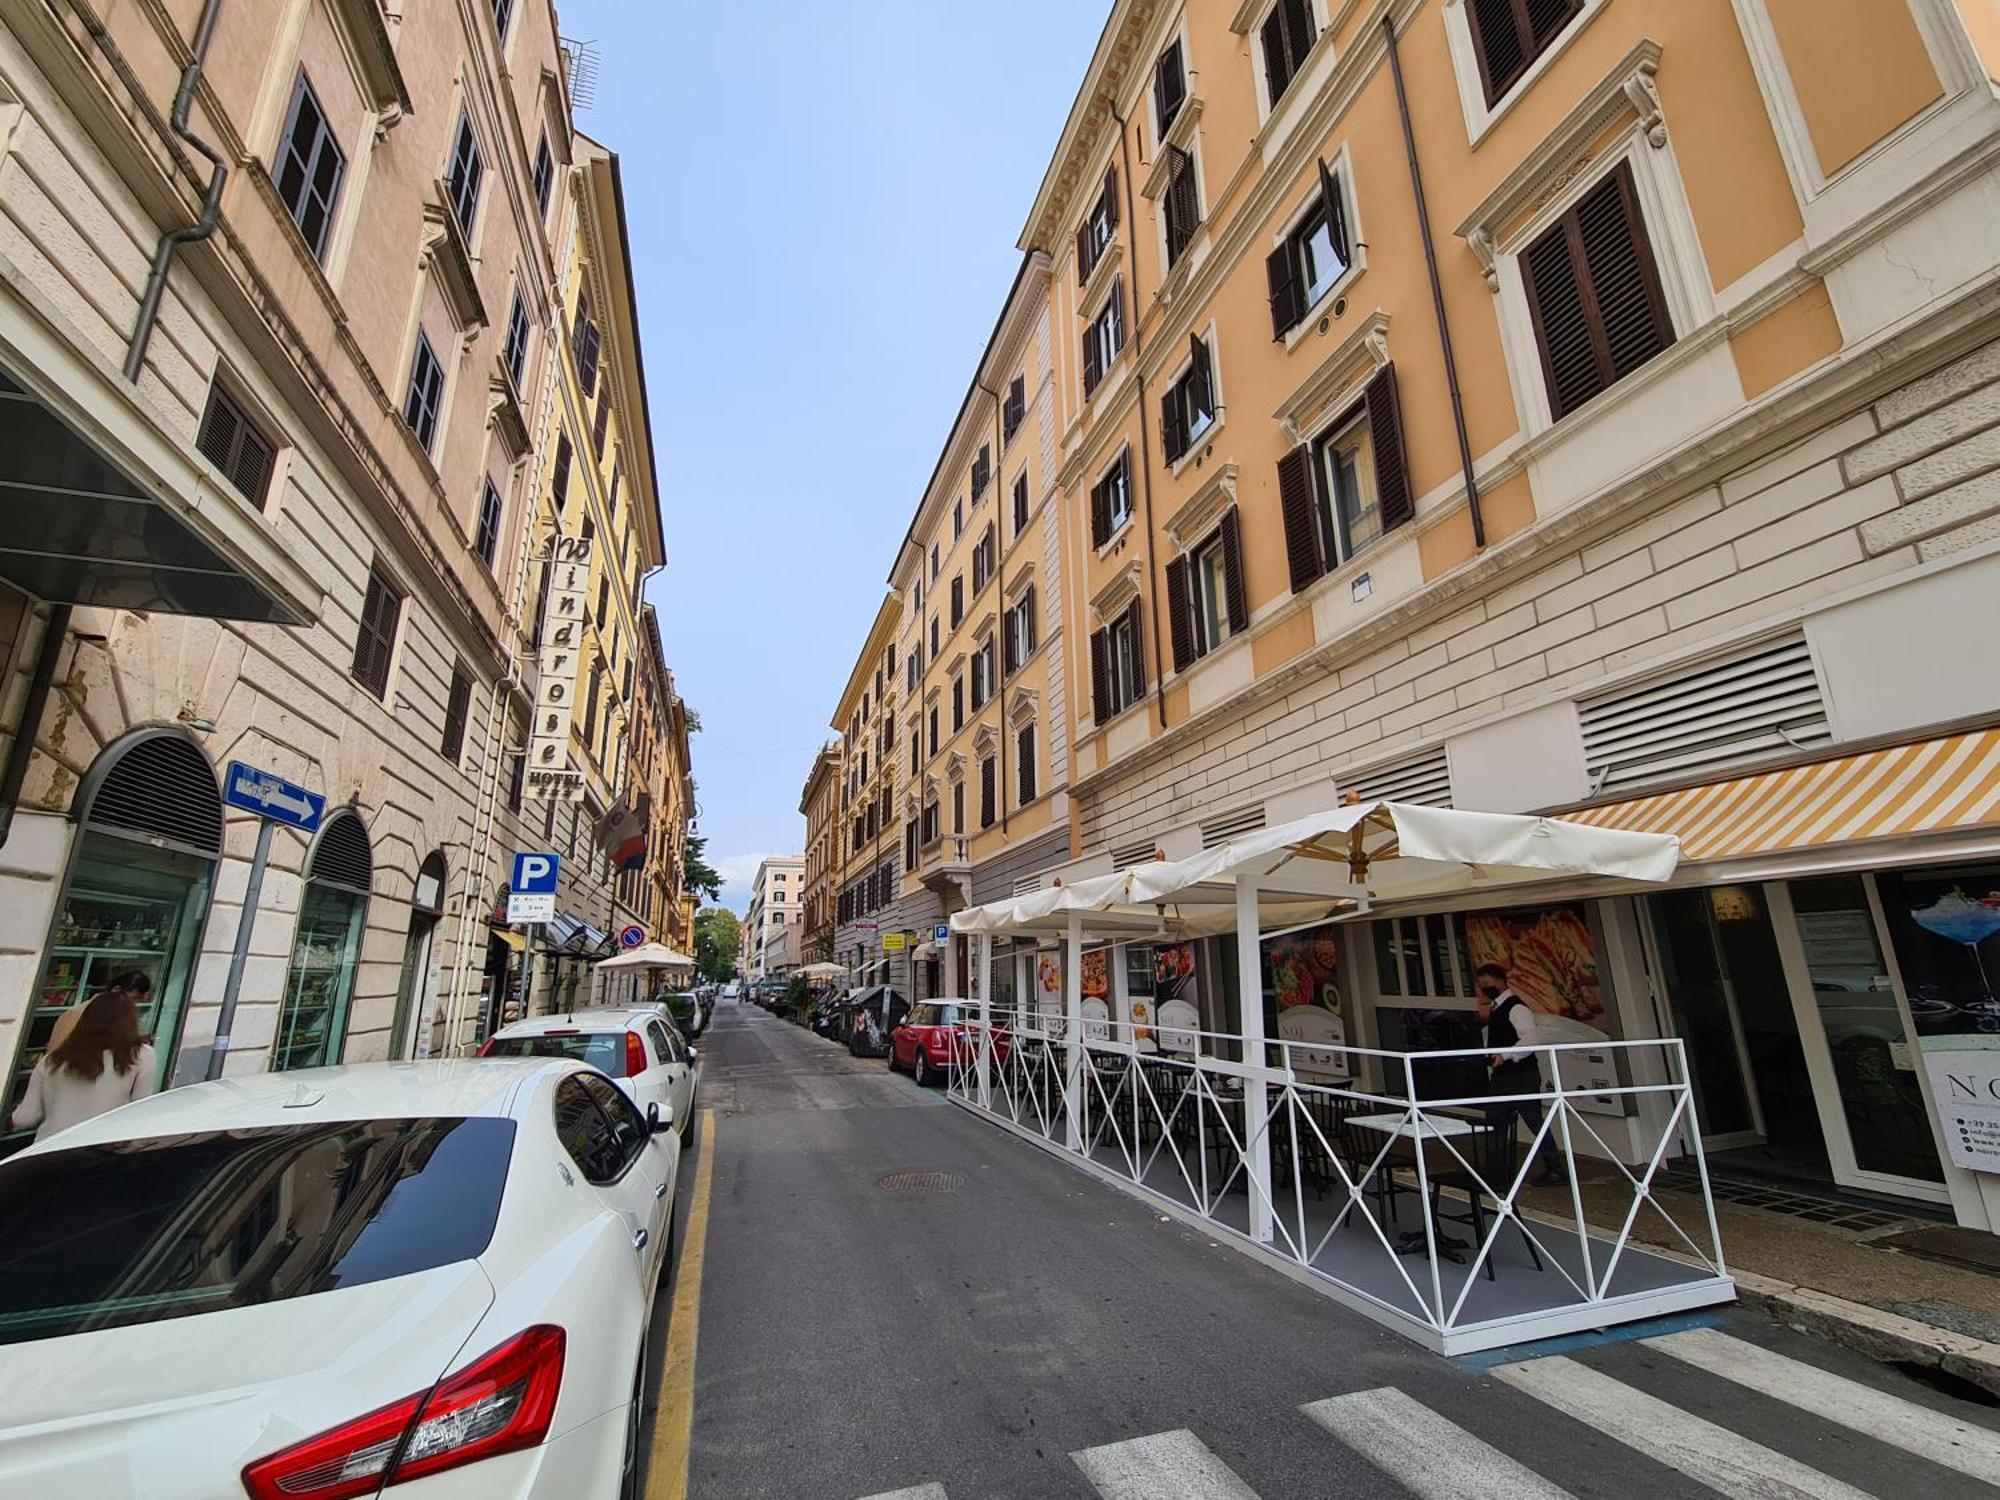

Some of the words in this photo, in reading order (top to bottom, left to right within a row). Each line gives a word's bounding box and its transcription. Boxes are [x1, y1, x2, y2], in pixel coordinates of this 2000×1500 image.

[528, 772, 583, 789] HOTEL
[519, 856, 550, 889] P
[938, 927, 946, 936] P
